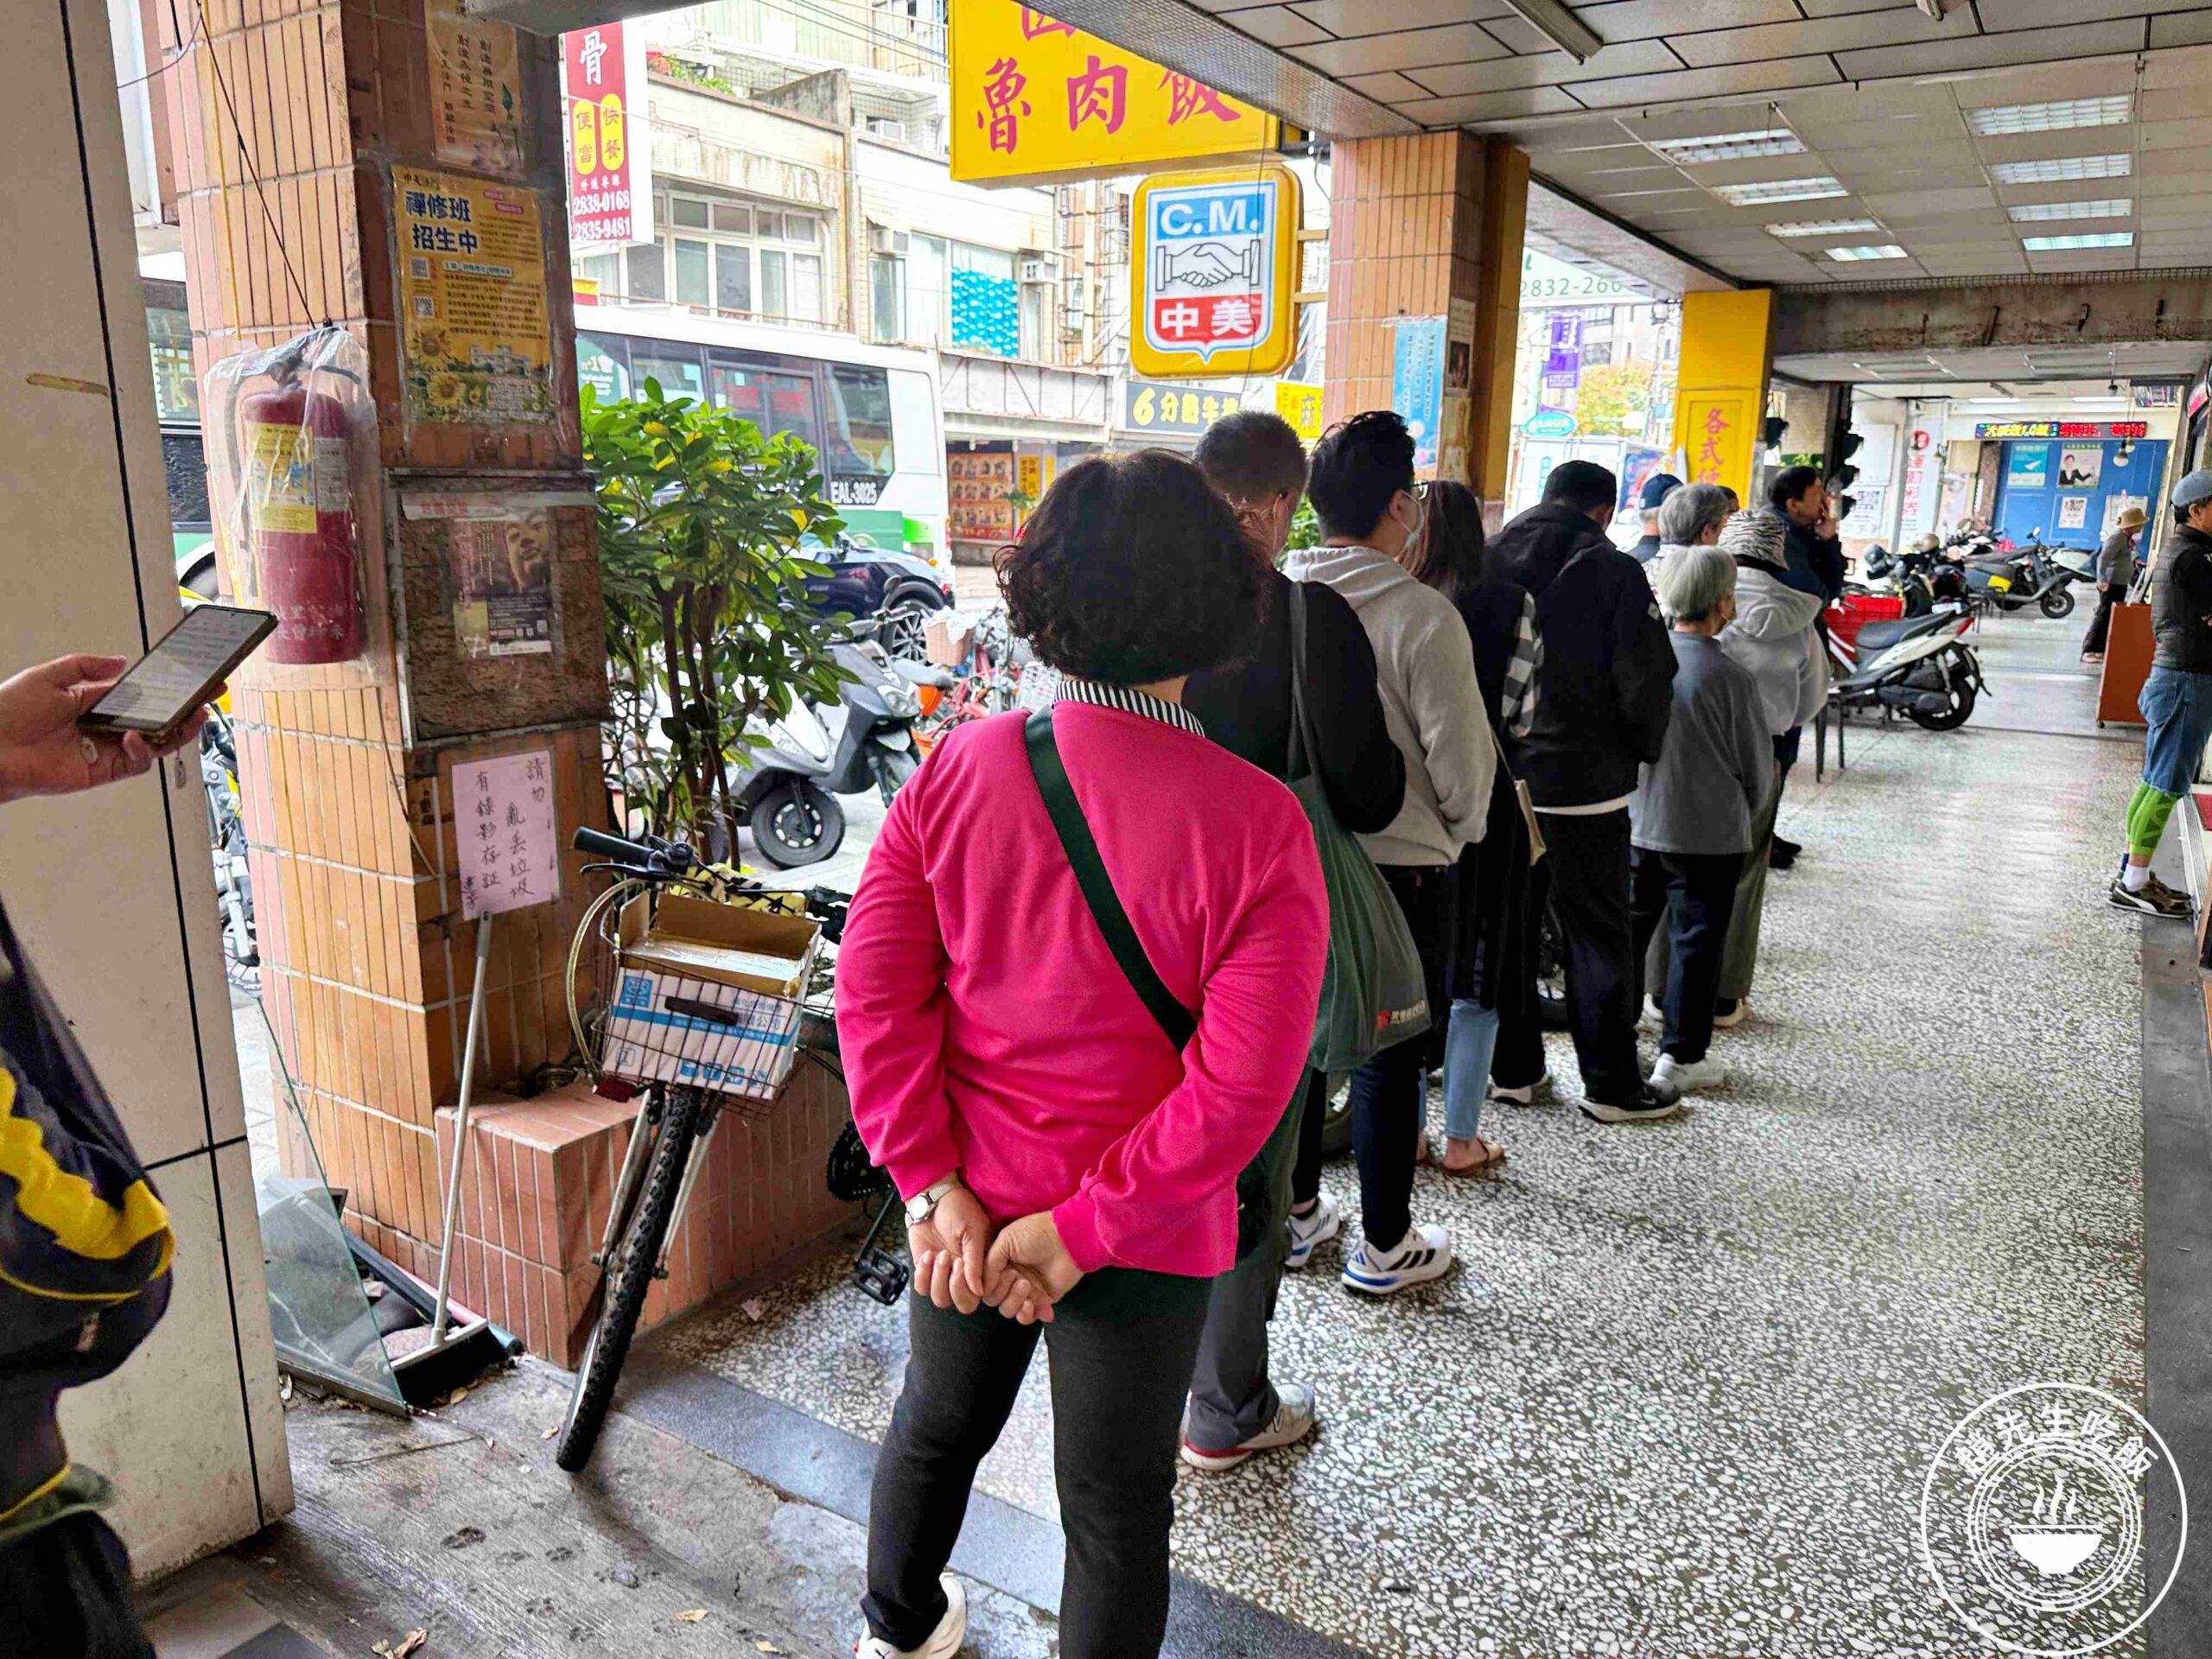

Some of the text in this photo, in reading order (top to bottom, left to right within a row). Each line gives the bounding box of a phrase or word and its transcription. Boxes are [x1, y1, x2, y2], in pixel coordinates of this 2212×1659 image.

[579, 30, 608, 86] 骨
[575, 111, 594, 163] 便當
[603, 105, 621, 160] 快餐
[405, 189, 473, 223] 禪修班
[573, 189, 631, 217] 2838-0168
[1160, 199, 1259, 235] C.M.
[412, 222, 479, 255] 招生中
[575, 216, 632, 242] 2835-9481
[1160, 299, 1254, 337] 中美
